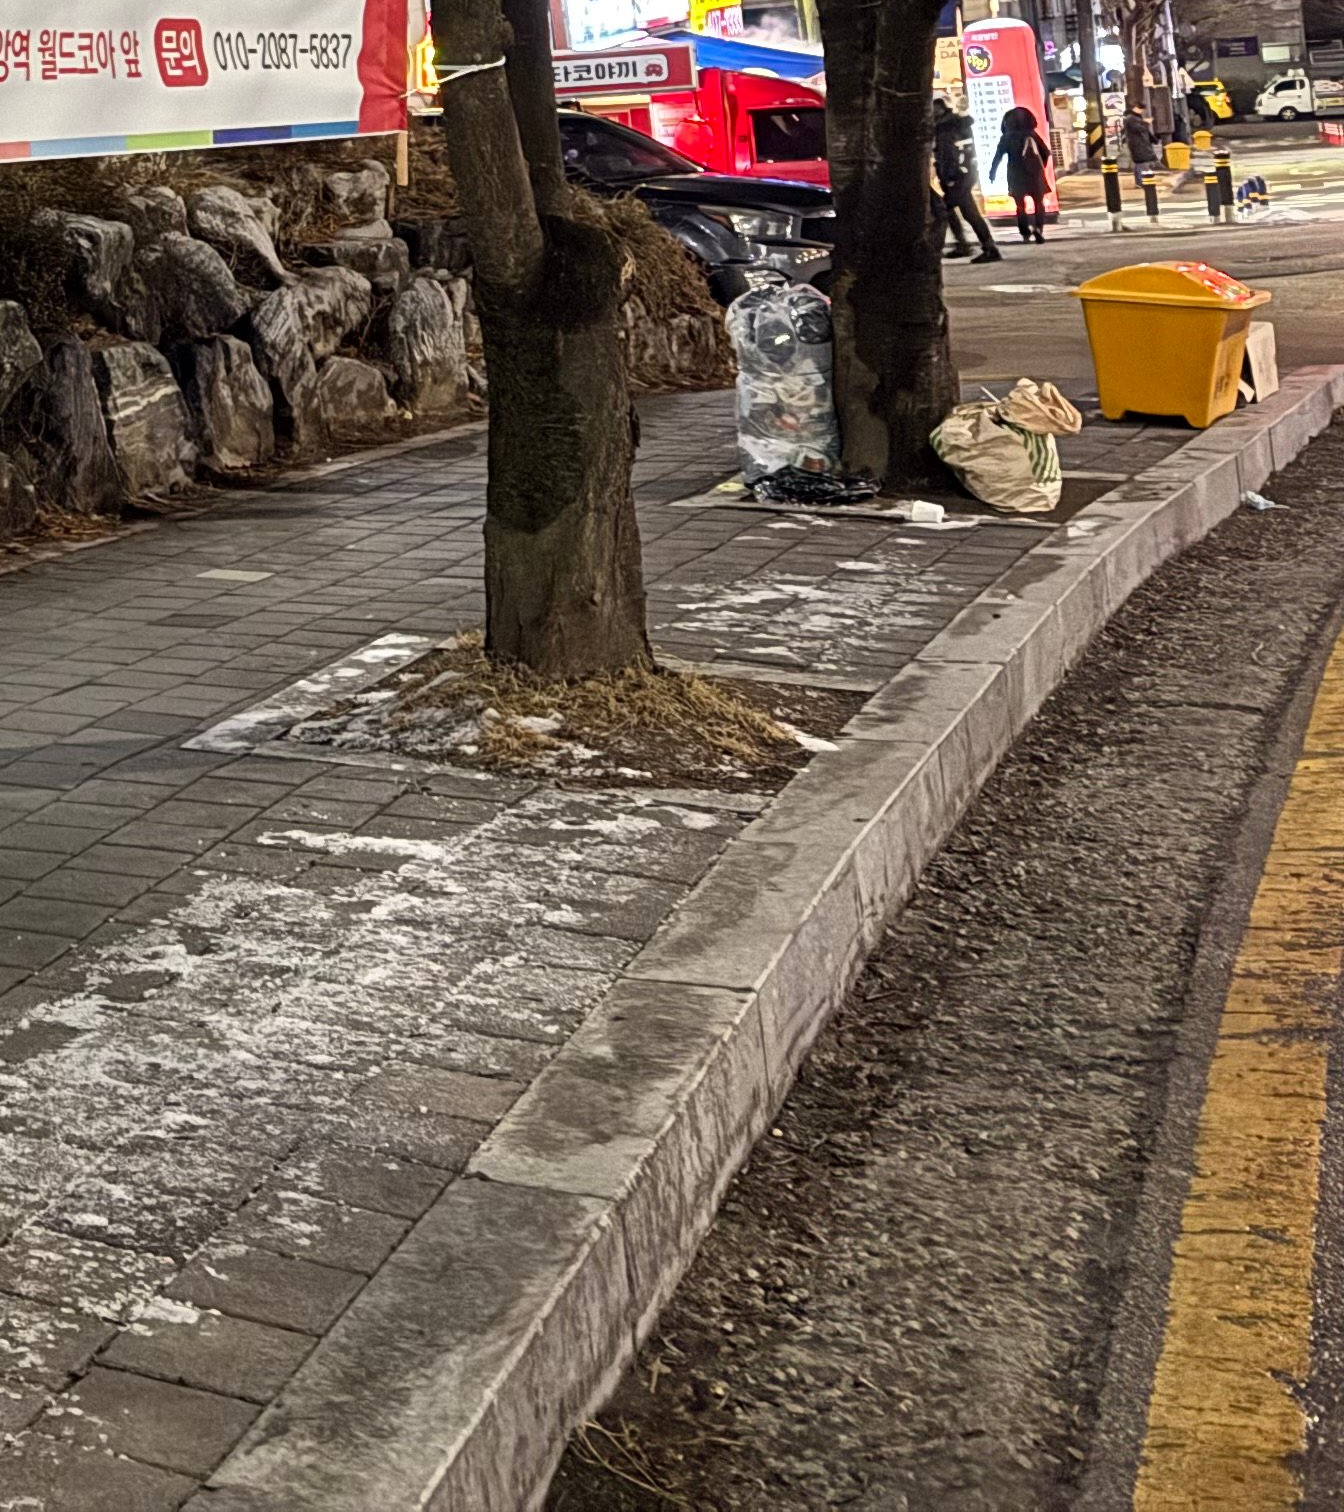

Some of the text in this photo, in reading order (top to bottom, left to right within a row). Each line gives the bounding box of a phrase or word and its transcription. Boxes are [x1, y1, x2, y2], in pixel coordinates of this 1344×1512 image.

[37, 28, 116, 82] 월드코아
[119, 30, 143, 80] 앞
[160, 28, 201, 77] 문의
[212, 31, 353, 72] 010-2087-5837
[553, 60, 639, 83] 타코야끼
